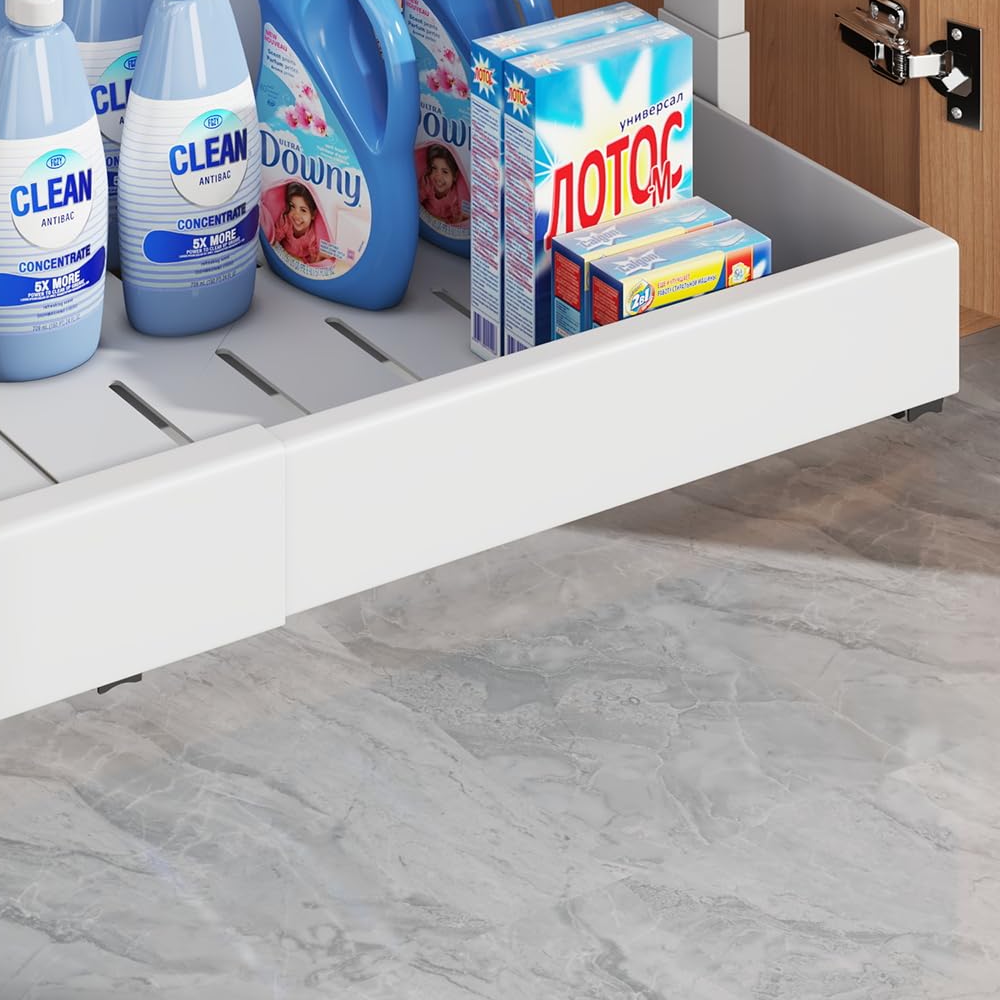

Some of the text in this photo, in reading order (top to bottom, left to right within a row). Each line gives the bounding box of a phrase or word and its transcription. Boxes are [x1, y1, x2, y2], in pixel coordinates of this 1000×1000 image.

[619, 92, 684, 132] универсал
[169, 128, 247, 176] CLEAN
[278, 138, 301, 151] ULTRA
[199, 170, 231, 186] ANTIBAC
[259, 129, 362, 208] Downy
[546, 110, 683, 250] ЛОТОС
[10, 168, 92, 217] CLEAN
[41, 211, 75, 228] ANTIBAC
[177, 202, 246, 230] CONCENTRATE
[192, 228, 237, 249] 5X MORE
[18, 244, 91, 273] CONCENTRATE
[34, 270, 80, 292] 5X MORE
